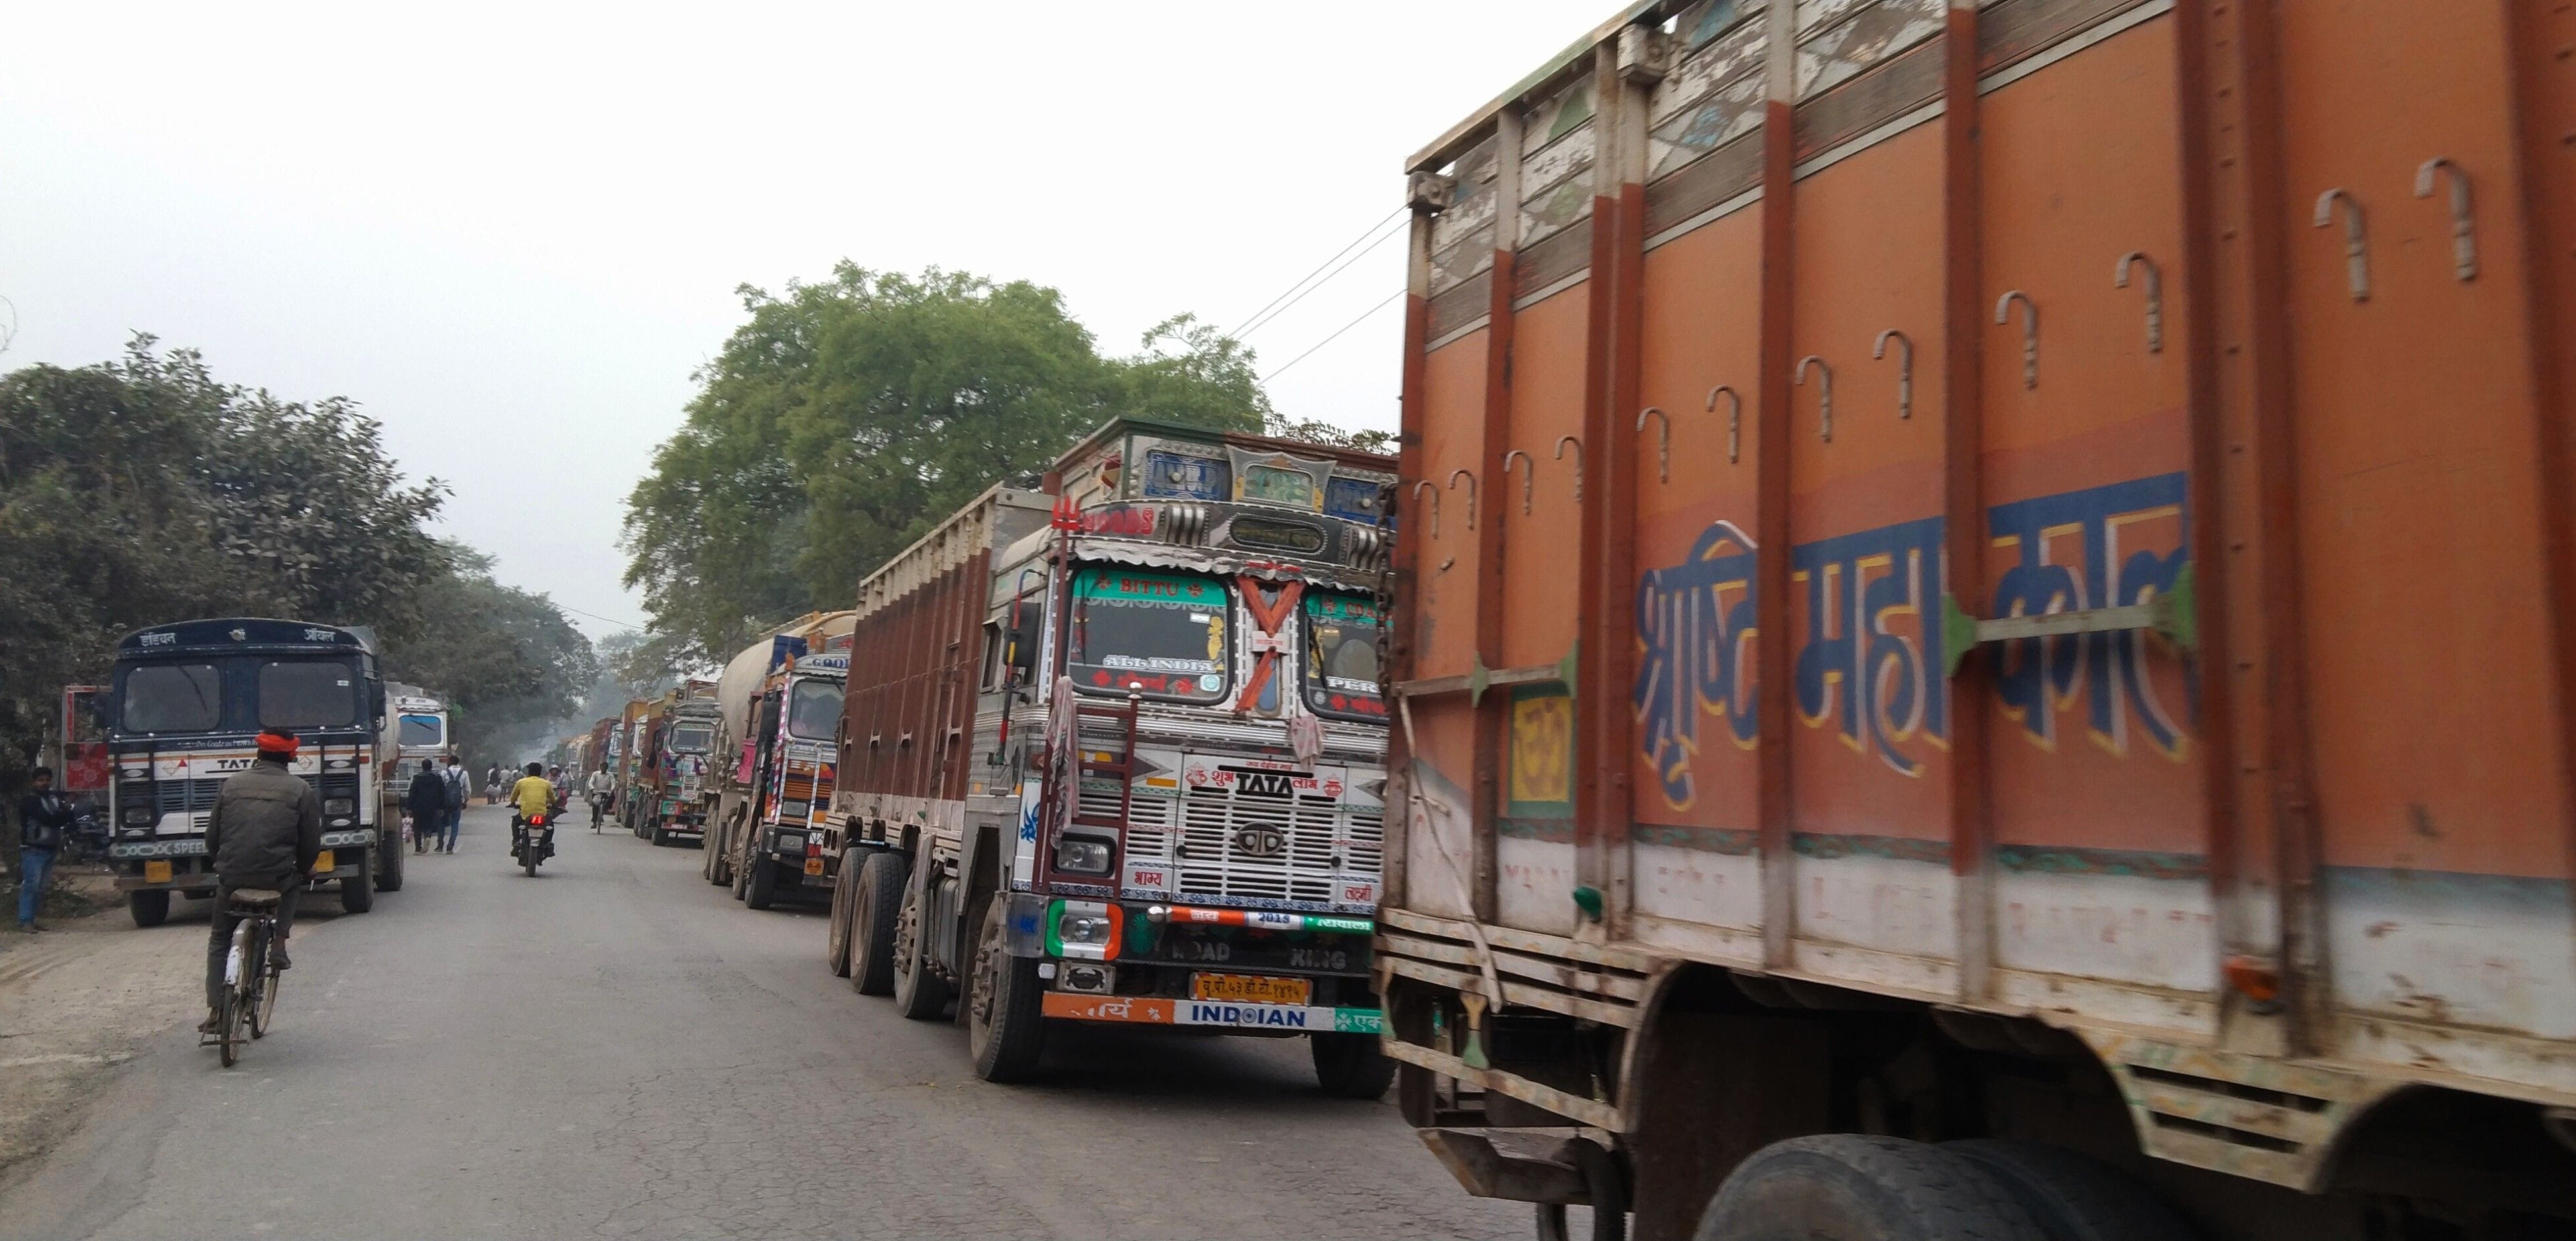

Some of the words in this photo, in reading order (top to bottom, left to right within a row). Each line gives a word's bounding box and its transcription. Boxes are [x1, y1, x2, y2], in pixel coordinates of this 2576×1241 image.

[1120, 578, 1179, 596] BITTU
[1104, 655, 1147, 670] ALL
[1148, 657, 1216, 673] INDIA
[1326, 677, 1380, 693] PER
[1212, 770, 1235, 787] शुभ
[1293, 778, 1318, 790] लाभ
[1236, 773, 1294, 794] TATA
[1134, 871, 1163, 886] भाग्य
[1192, 1005, 1306, 1027] INDIAN
